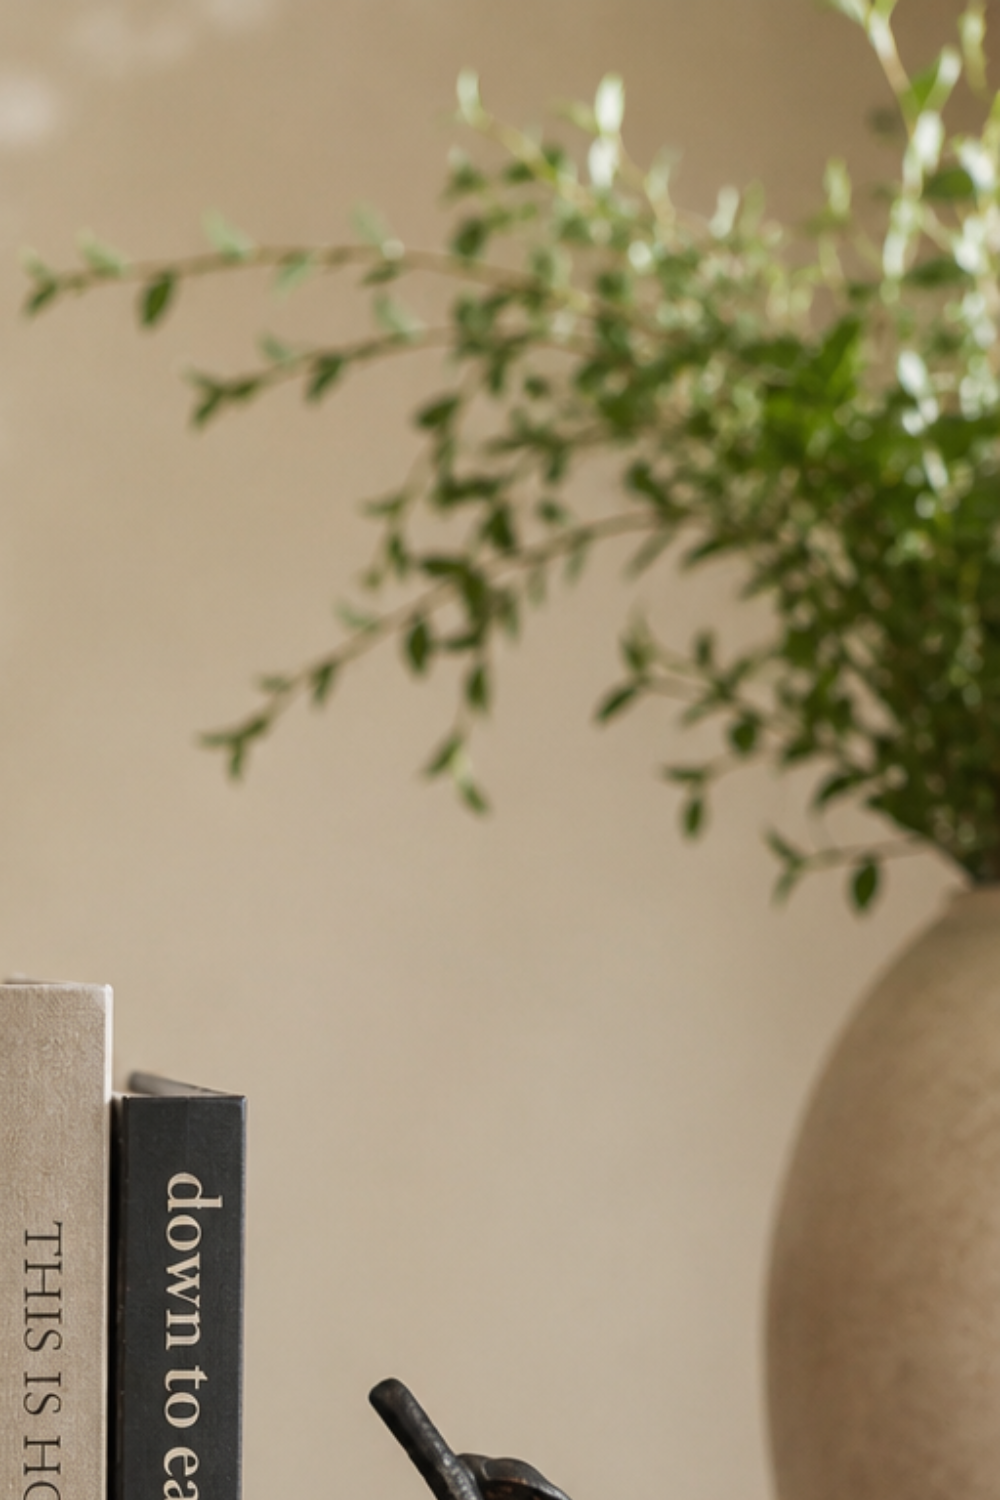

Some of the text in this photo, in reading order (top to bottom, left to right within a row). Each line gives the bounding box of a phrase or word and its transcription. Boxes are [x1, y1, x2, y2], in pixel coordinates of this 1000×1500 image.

[24, 1221, 63, 1352] THIS
[165, 1172, 223, 1350] down
[23, 1372, 62, 1416] IS
[164, 1365, 208, 1428] to
